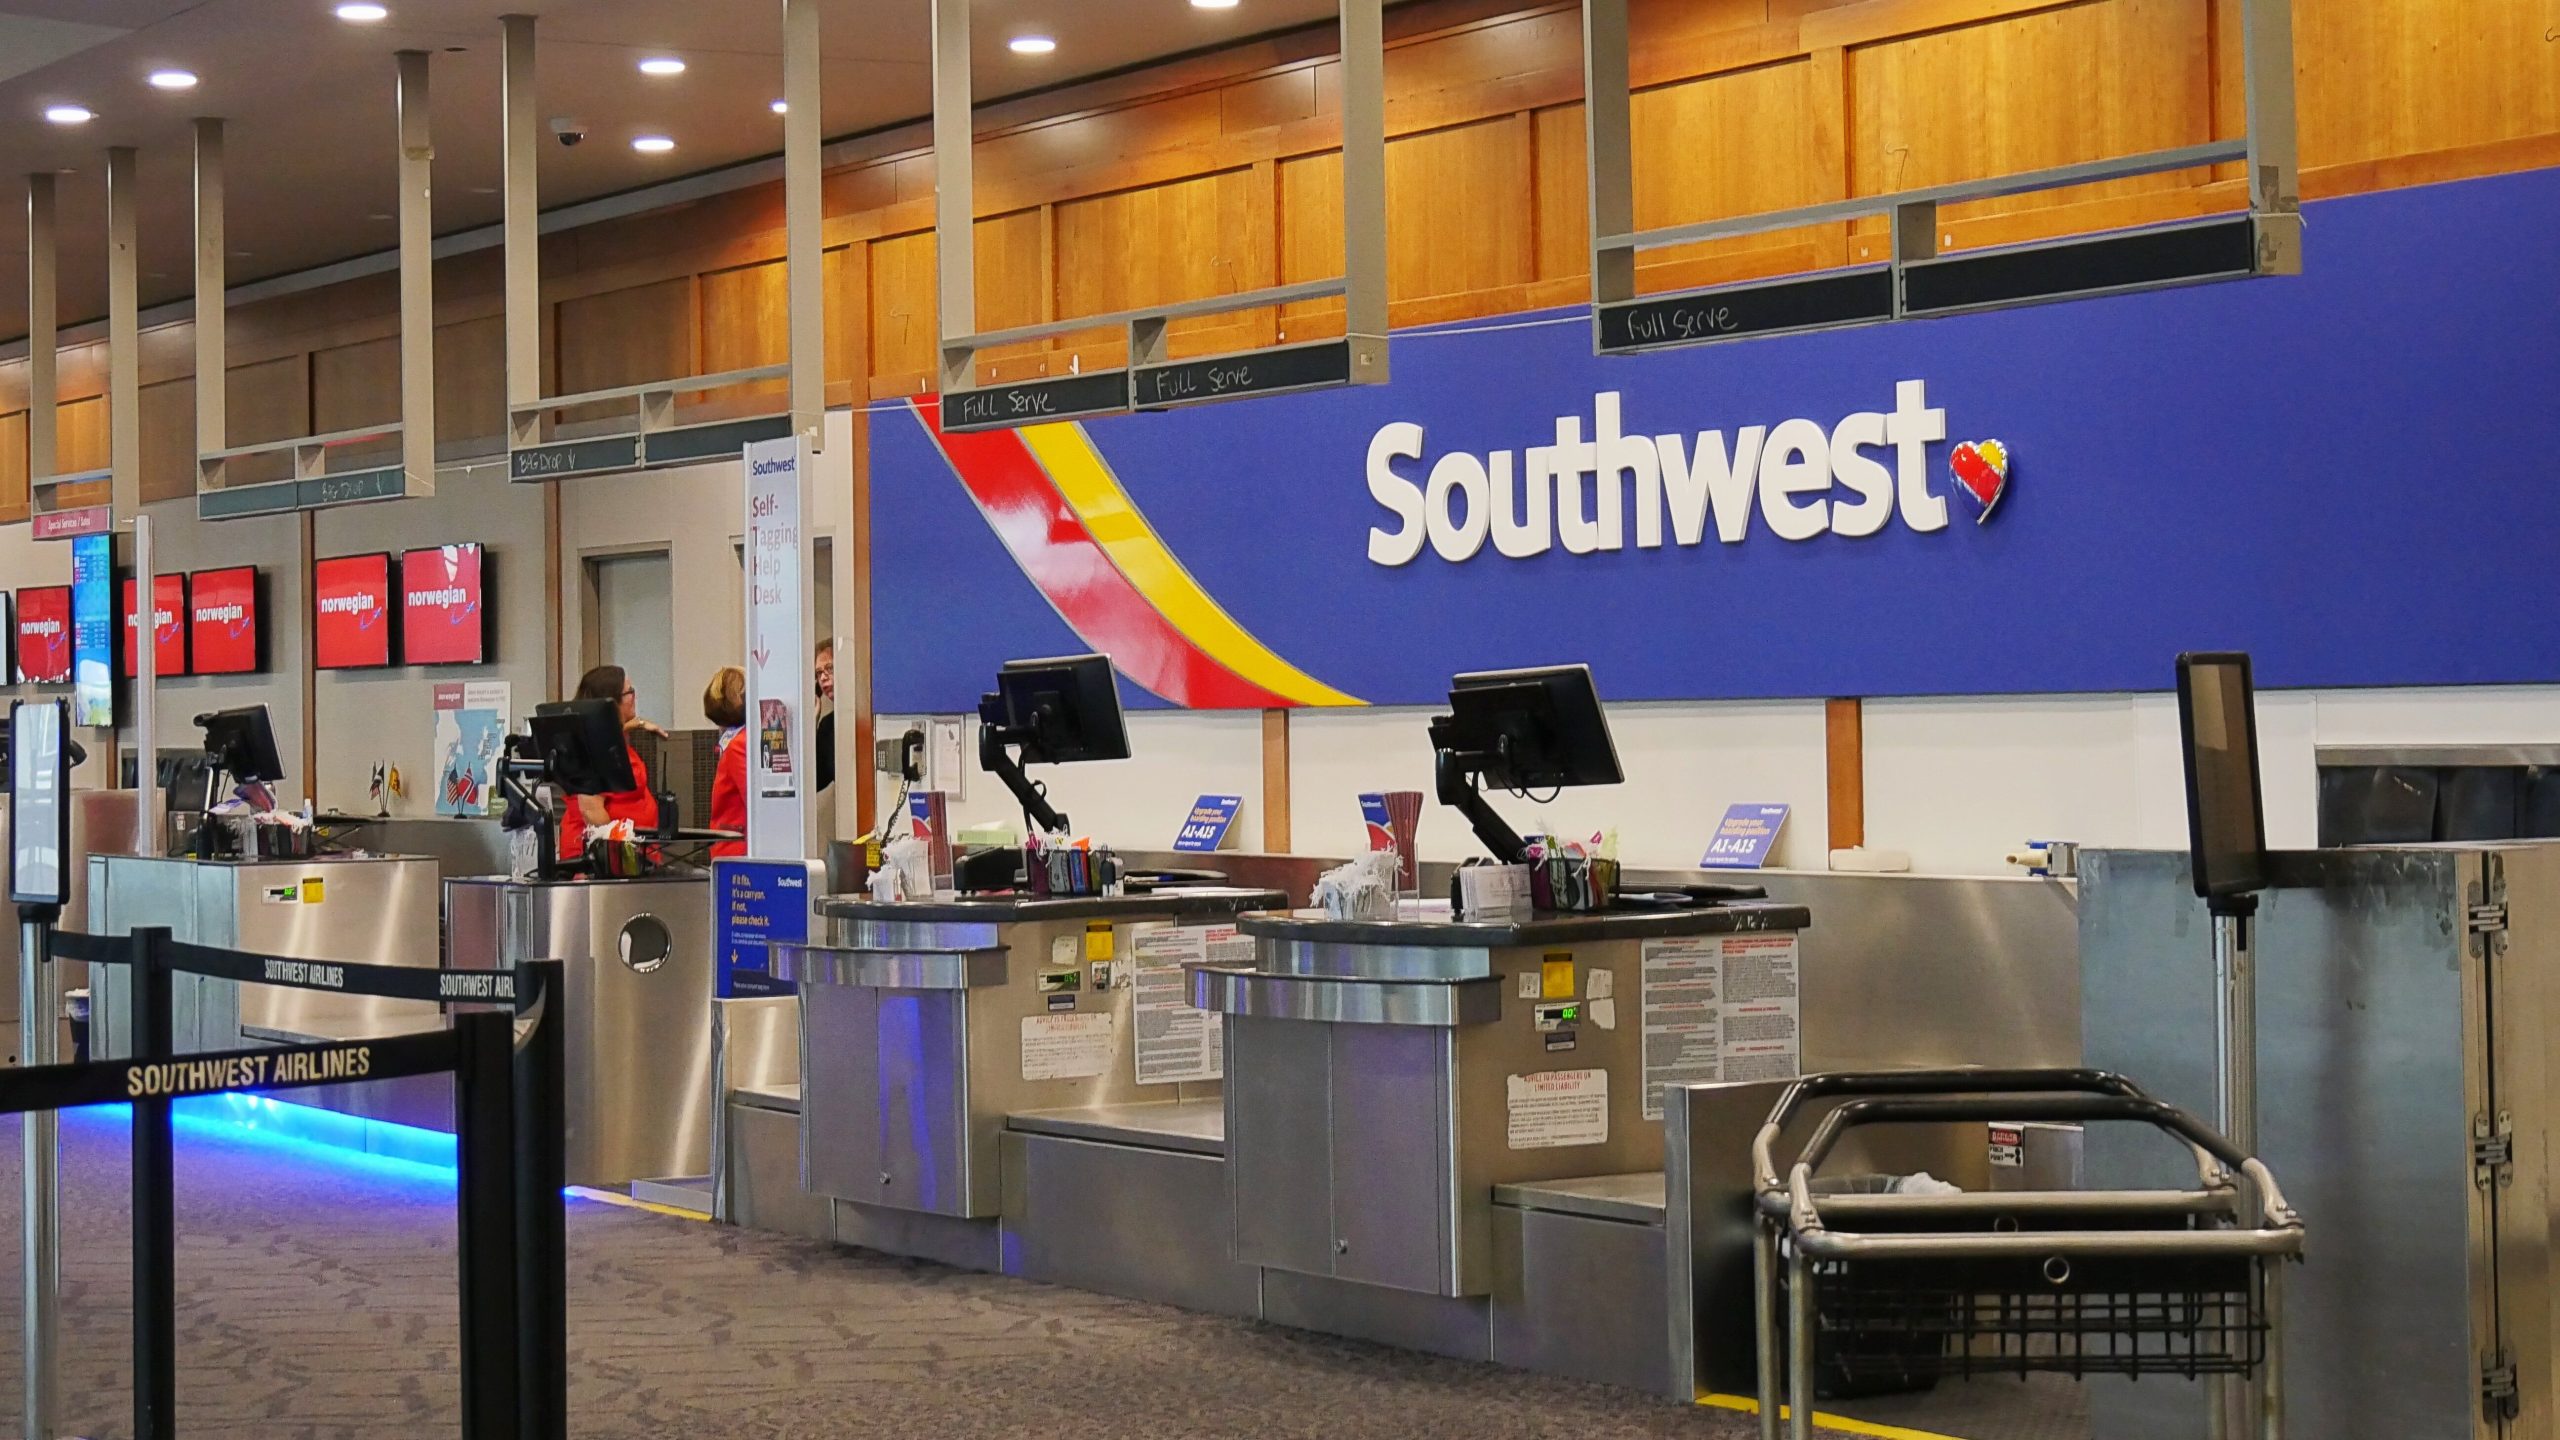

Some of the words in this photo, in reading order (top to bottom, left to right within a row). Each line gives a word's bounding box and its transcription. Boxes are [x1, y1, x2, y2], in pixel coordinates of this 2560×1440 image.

[1673, 306, 1738, 338] Serve
[1207, 365, 1252, 392] Serve
[752, 456, 796, 476] Southwest
[1367, 379, 1948, 567] Southwest
[752, 494, 779, 518] Self-
[48, 519, 61, 531] Special
[62, 518, 77, 529] Services
[752, 522, 798, 550] Tagging
[753, 555, 781, 577] Help
[321, 592, 374, 615] norwegian
[408, 585, 466, 609] norwegian
[754, 583, 783, 606] Desk
[128, 608, 173, 629] nogian
[196, 602, 243, 624] norwegian
[21, 618, 60, 638] norwegian
[1181, 825, 1216, 839] A1-A15
[1710, 838, 1757, 854] A1-A15
[777, 877, 803, 887] Southwest
[264, 959, 309, 983] SOUTHWEST
[308, 963, 344, 988] AIRLINES
[440, 972, 493, 998] SOUTHWEST
[127, 1055, 268, 1097] SOUTHWEST
[273, 1045, 371, 1082] AIRLINES
